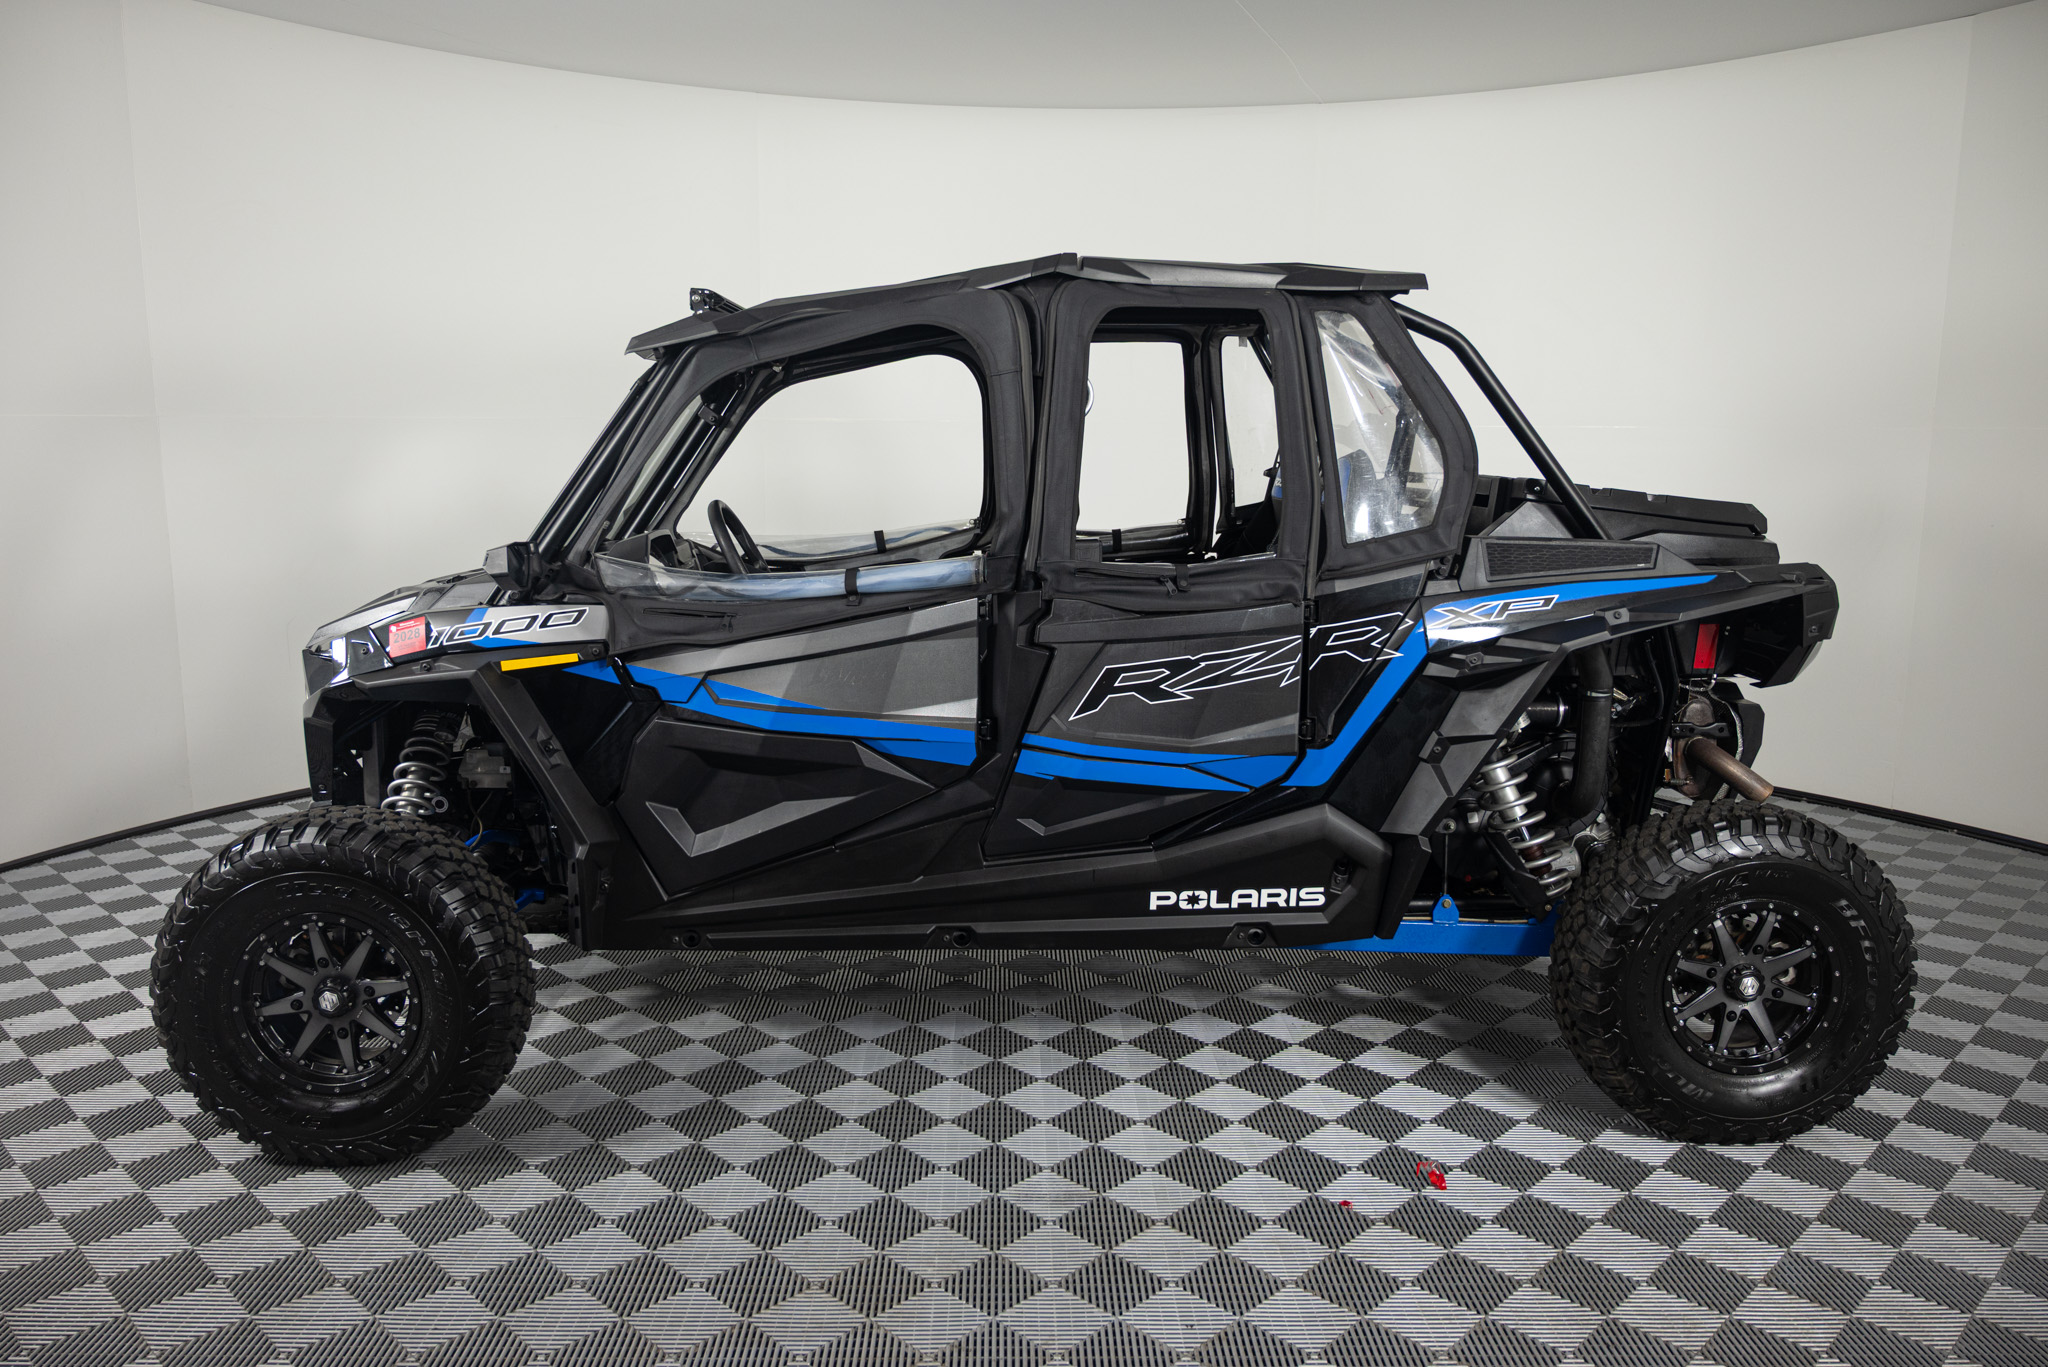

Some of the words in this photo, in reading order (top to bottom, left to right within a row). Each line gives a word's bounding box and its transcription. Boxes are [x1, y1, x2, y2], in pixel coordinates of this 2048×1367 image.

[428, 607, 590, 649] 1000
[1427, 594, 1560, 629] XP
[393, 627, 421, 644] 2028
[1067, 612, 1415, 721] RZR
[1148, 886, 1326, 911] POLARIS
